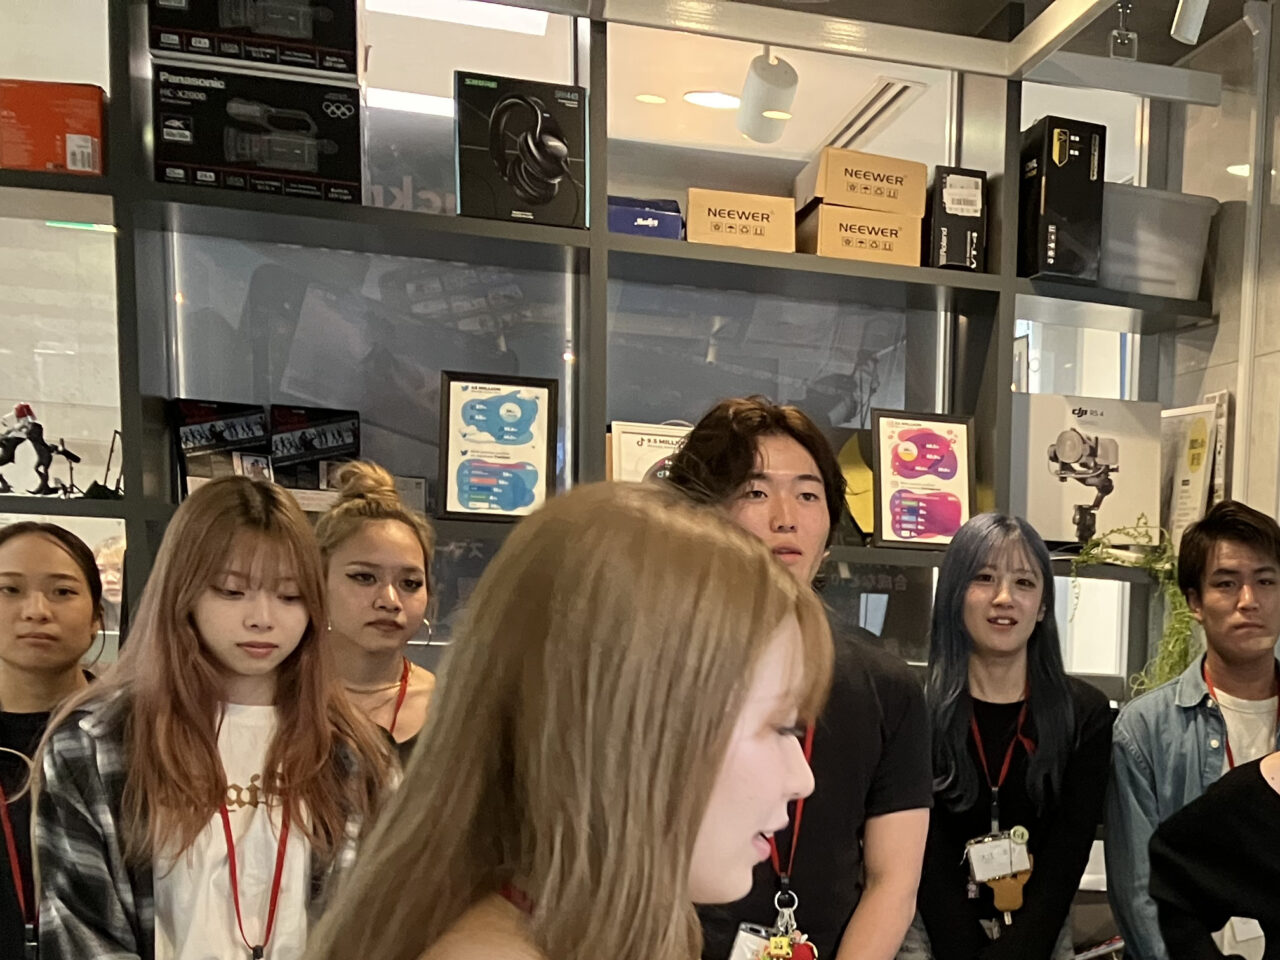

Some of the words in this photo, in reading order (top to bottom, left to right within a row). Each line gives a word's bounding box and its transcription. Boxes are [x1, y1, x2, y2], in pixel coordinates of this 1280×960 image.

[159, 71, 226, 90] Panasonic
[844, 168, 904, 187] NEEWER
[708, 207, 771, 223] NEEWER
[839, 223, 899, 239] NEEWER
[940, 227, 948, 255] Roland
